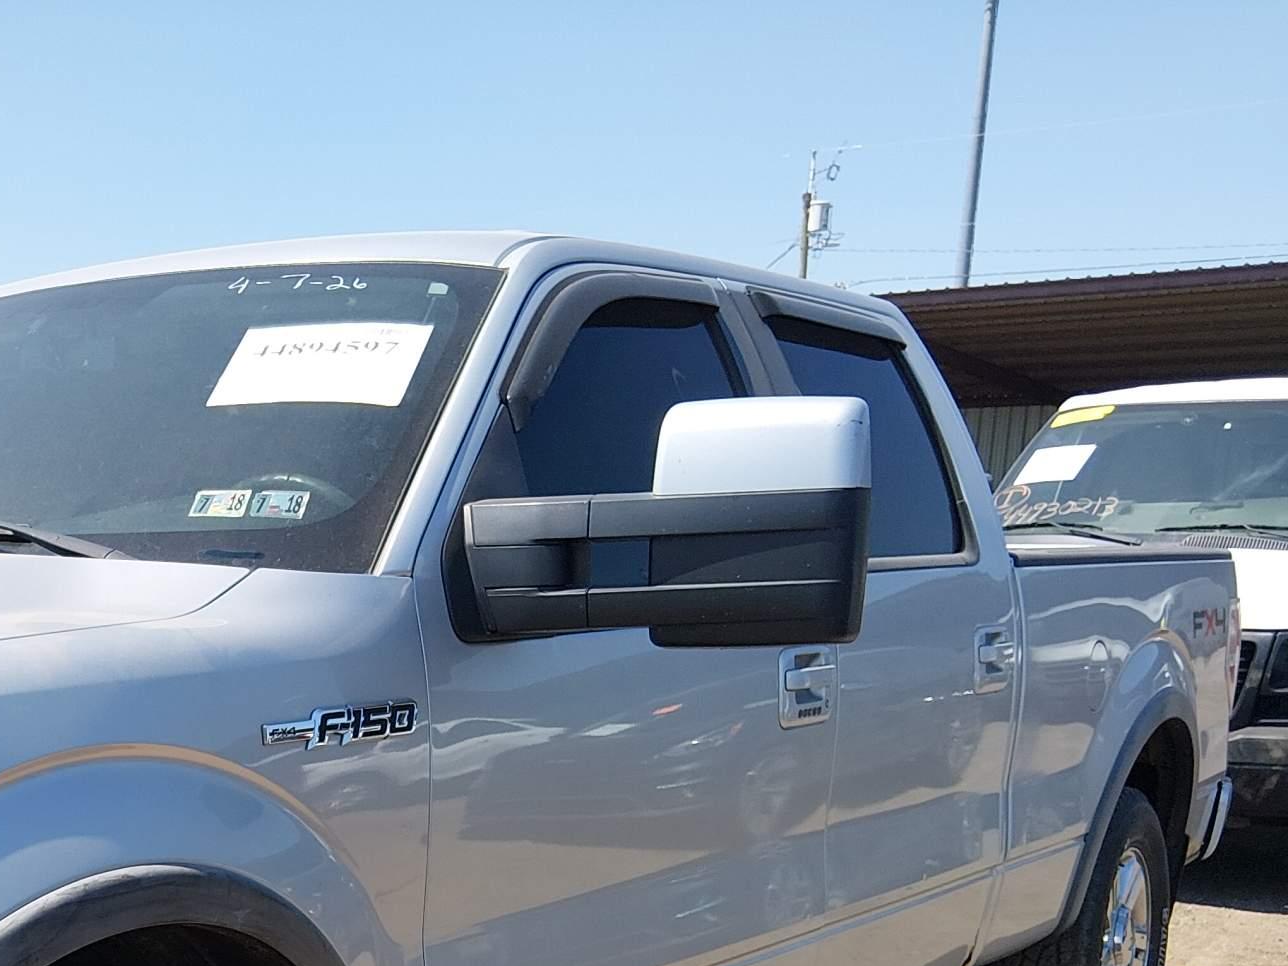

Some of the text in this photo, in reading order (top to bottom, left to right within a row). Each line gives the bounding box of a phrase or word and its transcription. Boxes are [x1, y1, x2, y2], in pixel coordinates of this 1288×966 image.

[198, 493, 246, 513] 7 18
[255, 494, 303, 514] 7 18
[1193, 607, 1226, 639] FX4
